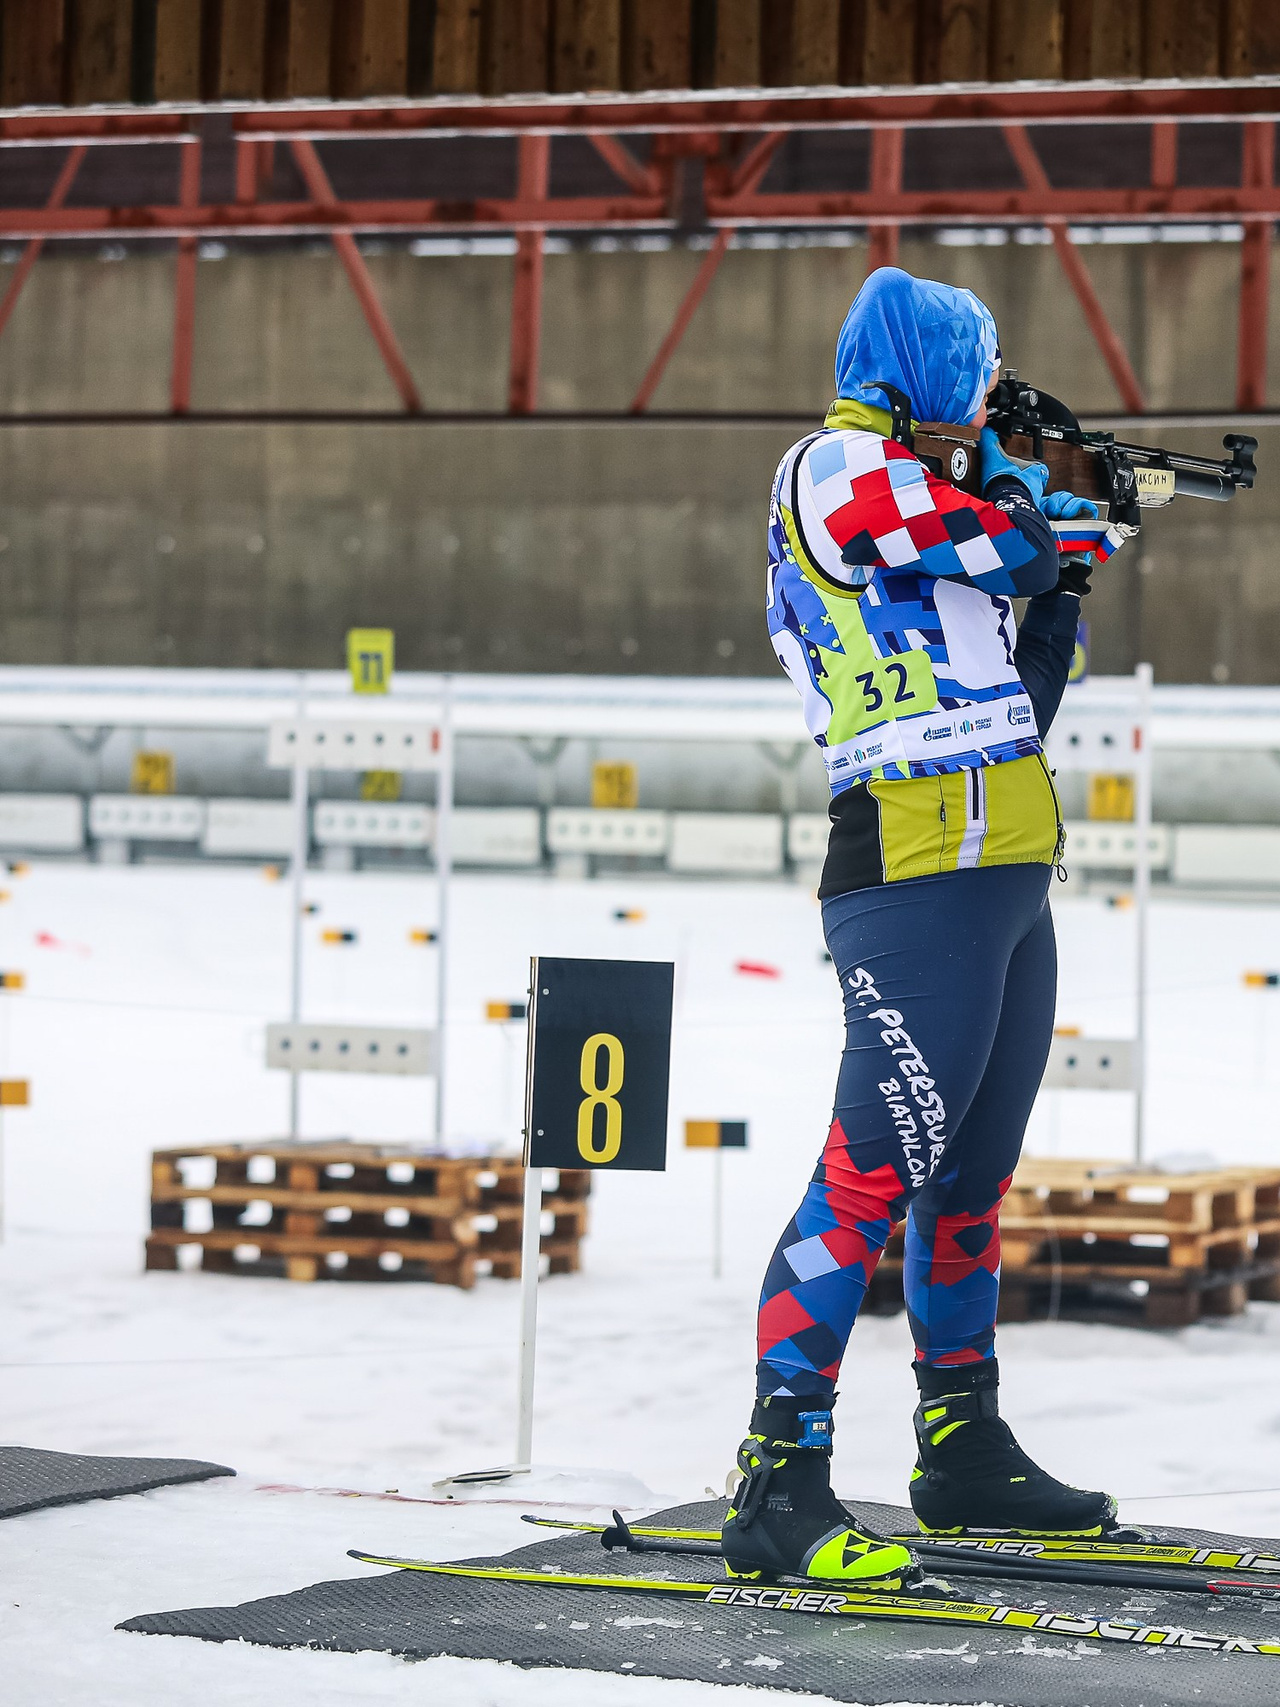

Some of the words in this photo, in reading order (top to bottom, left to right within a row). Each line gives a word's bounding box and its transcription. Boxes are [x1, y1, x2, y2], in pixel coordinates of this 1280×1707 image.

[359, 651, 383, 684] 11
[854, 662, 916, 712] 32
[577, 1032, 625, 1164] 8
[878, 1078, 926, 1187] BIATHLON
[704, 1586, 848, 1614] FISCHER
